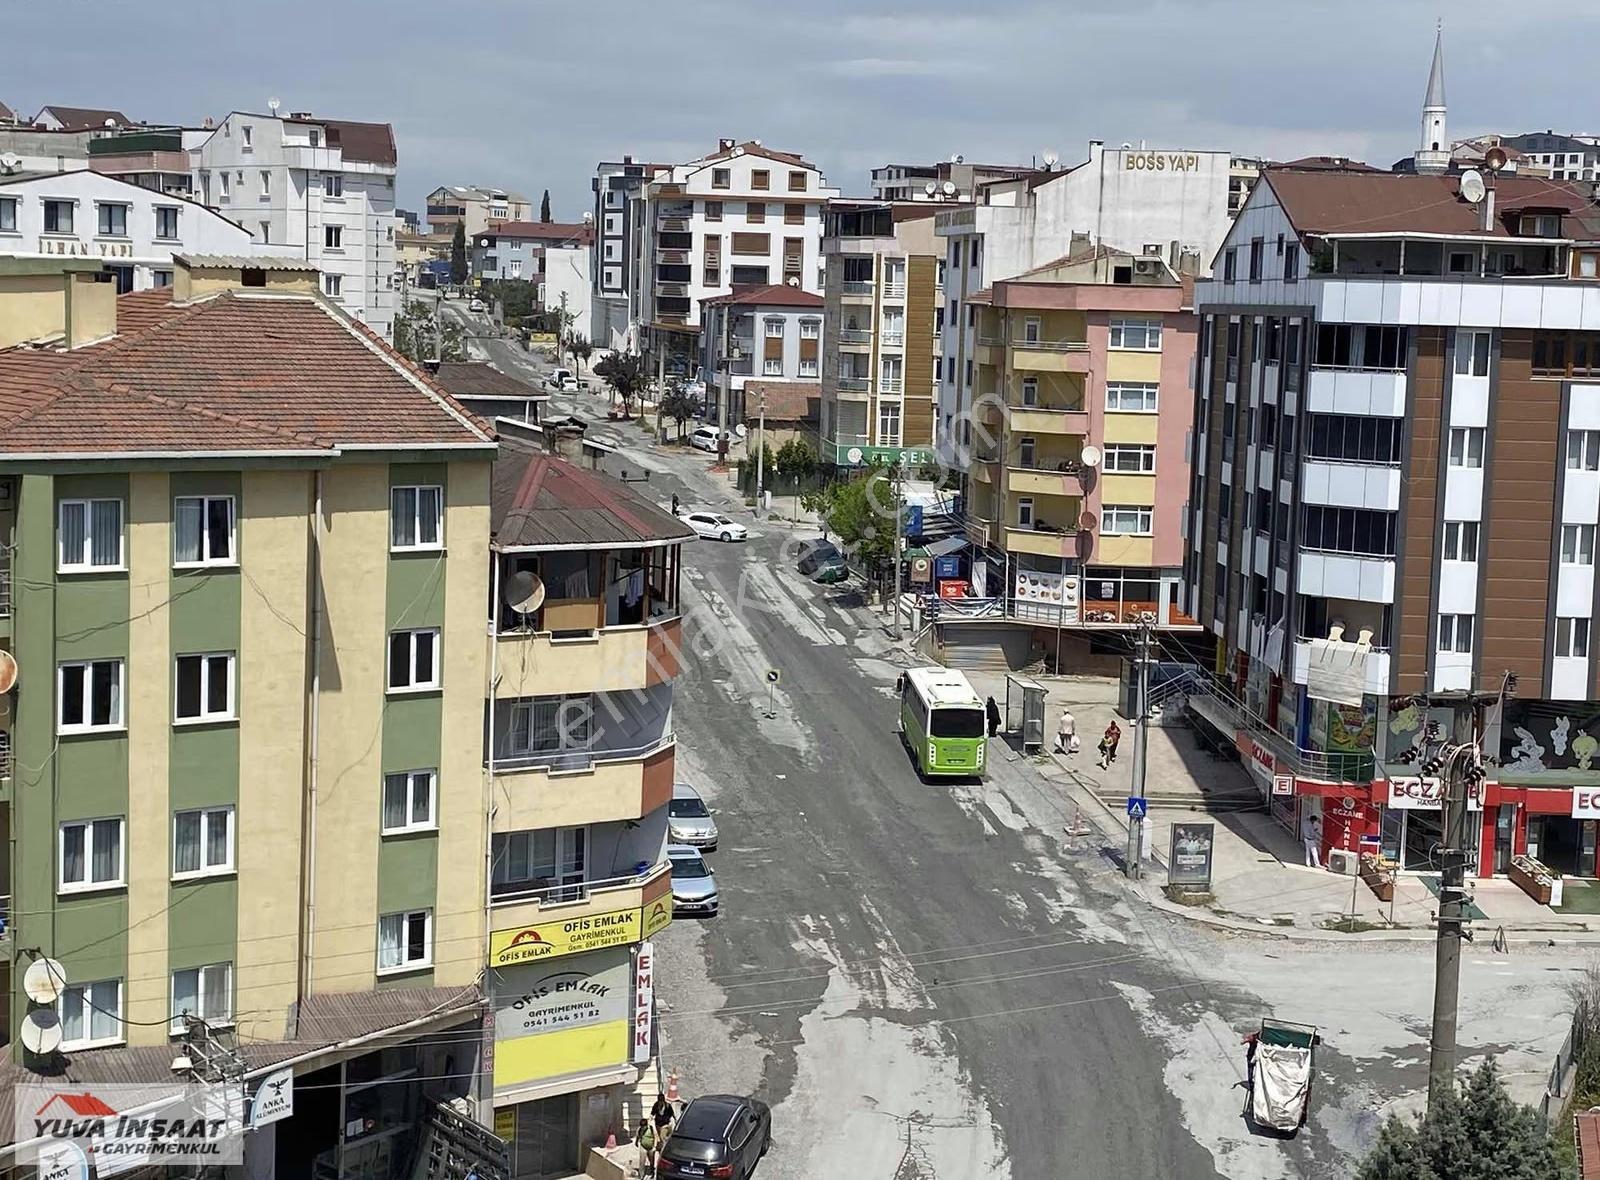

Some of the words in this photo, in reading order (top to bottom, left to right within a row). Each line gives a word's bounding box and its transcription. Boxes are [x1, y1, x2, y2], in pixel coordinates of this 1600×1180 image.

[1126, 155, 1165, 171] BOSS
[1169, 155, 1199, 172] YAPI
[99, 243, 133, 257] YAPI
[1278, 781, 1288, 791] E
[564, 918, 590, 933] OFİS
[594, 912, 633, 928] EMLAK
[570, 927, 626, 943] GAYRİMENKUL
[522, 946, 551, 959] EMLAK
[555, 980, 610, 998] EMLAK
[636, 956, 651, 1046] EMLAK
[523, 1018, 547, 1028] 0541
[552, 1014, 570, 1024] 544
[573, 1012, 584, 1020] 51
[588, 1009, 600, 1018] 82
[262, 1097, 285, 1110] ANKA
